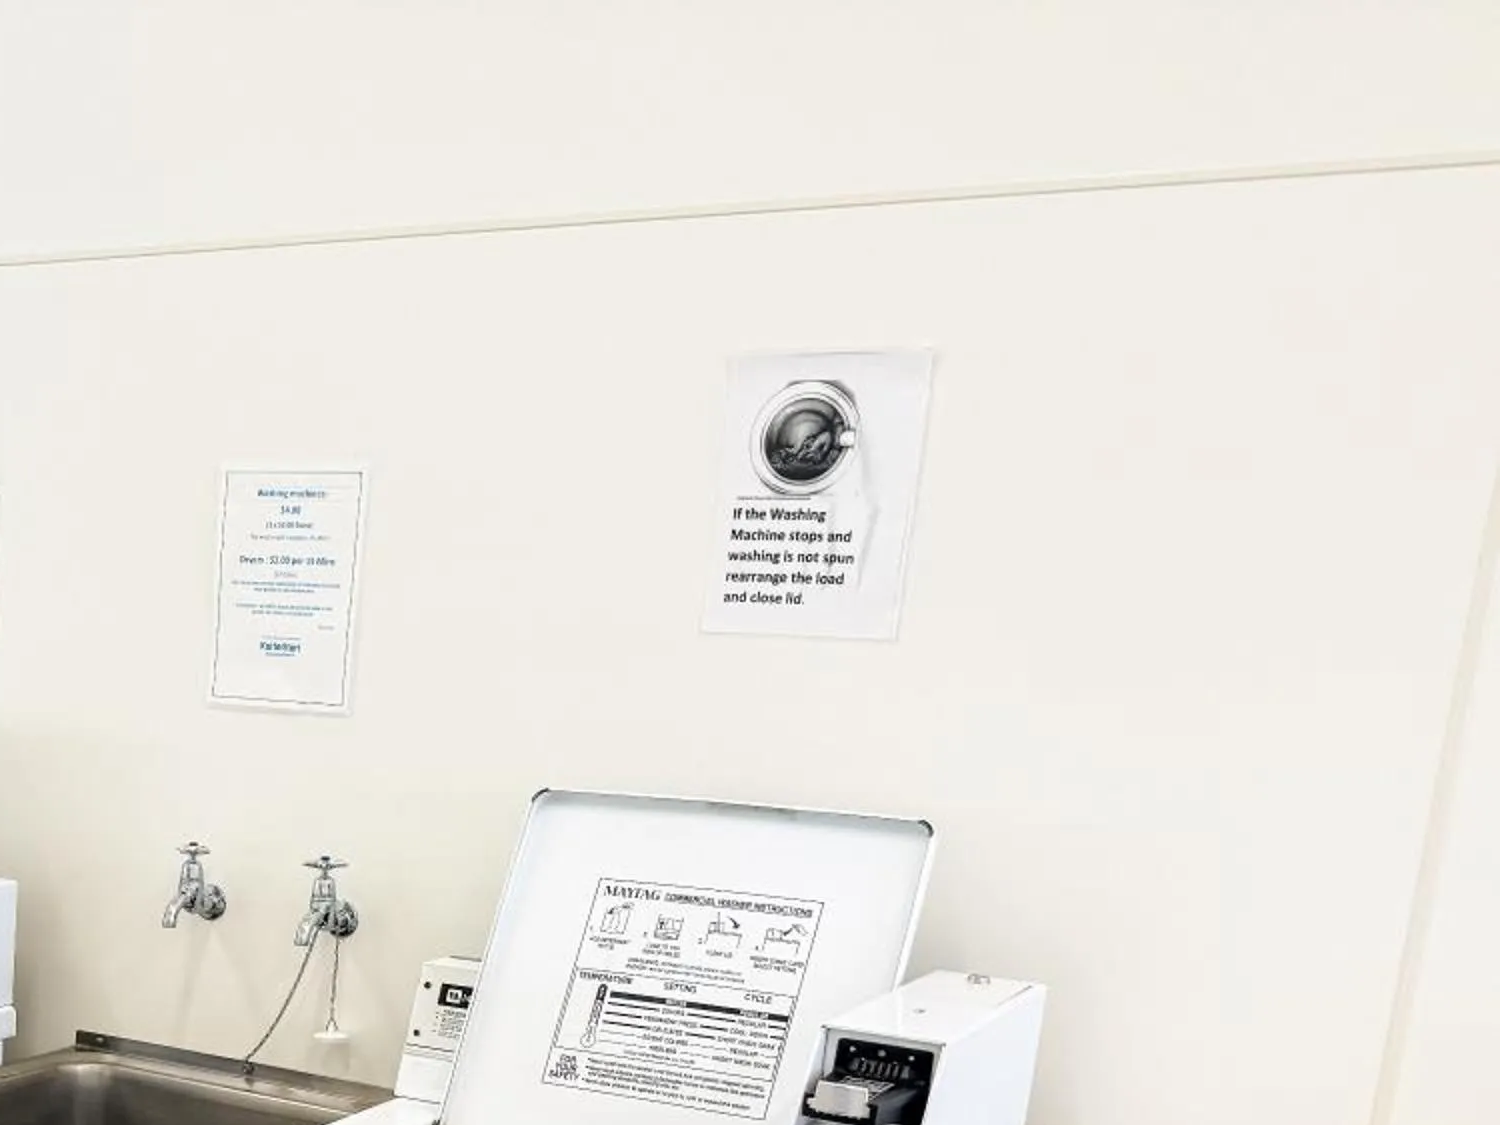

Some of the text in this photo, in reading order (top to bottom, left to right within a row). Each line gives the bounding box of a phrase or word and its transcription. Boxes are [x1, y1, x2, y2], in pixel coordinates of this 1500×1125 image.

[732, 508, 827, 523] If the Washing
[730, 529, 852, 543] Machine stops and
[727, 550, 854, 566] washing is not spun
[725, 571, 845, 586] rearrange the load
[723, 591, 804, 605] and close lid.
[603, 885, 661, 901] MAYTAG
